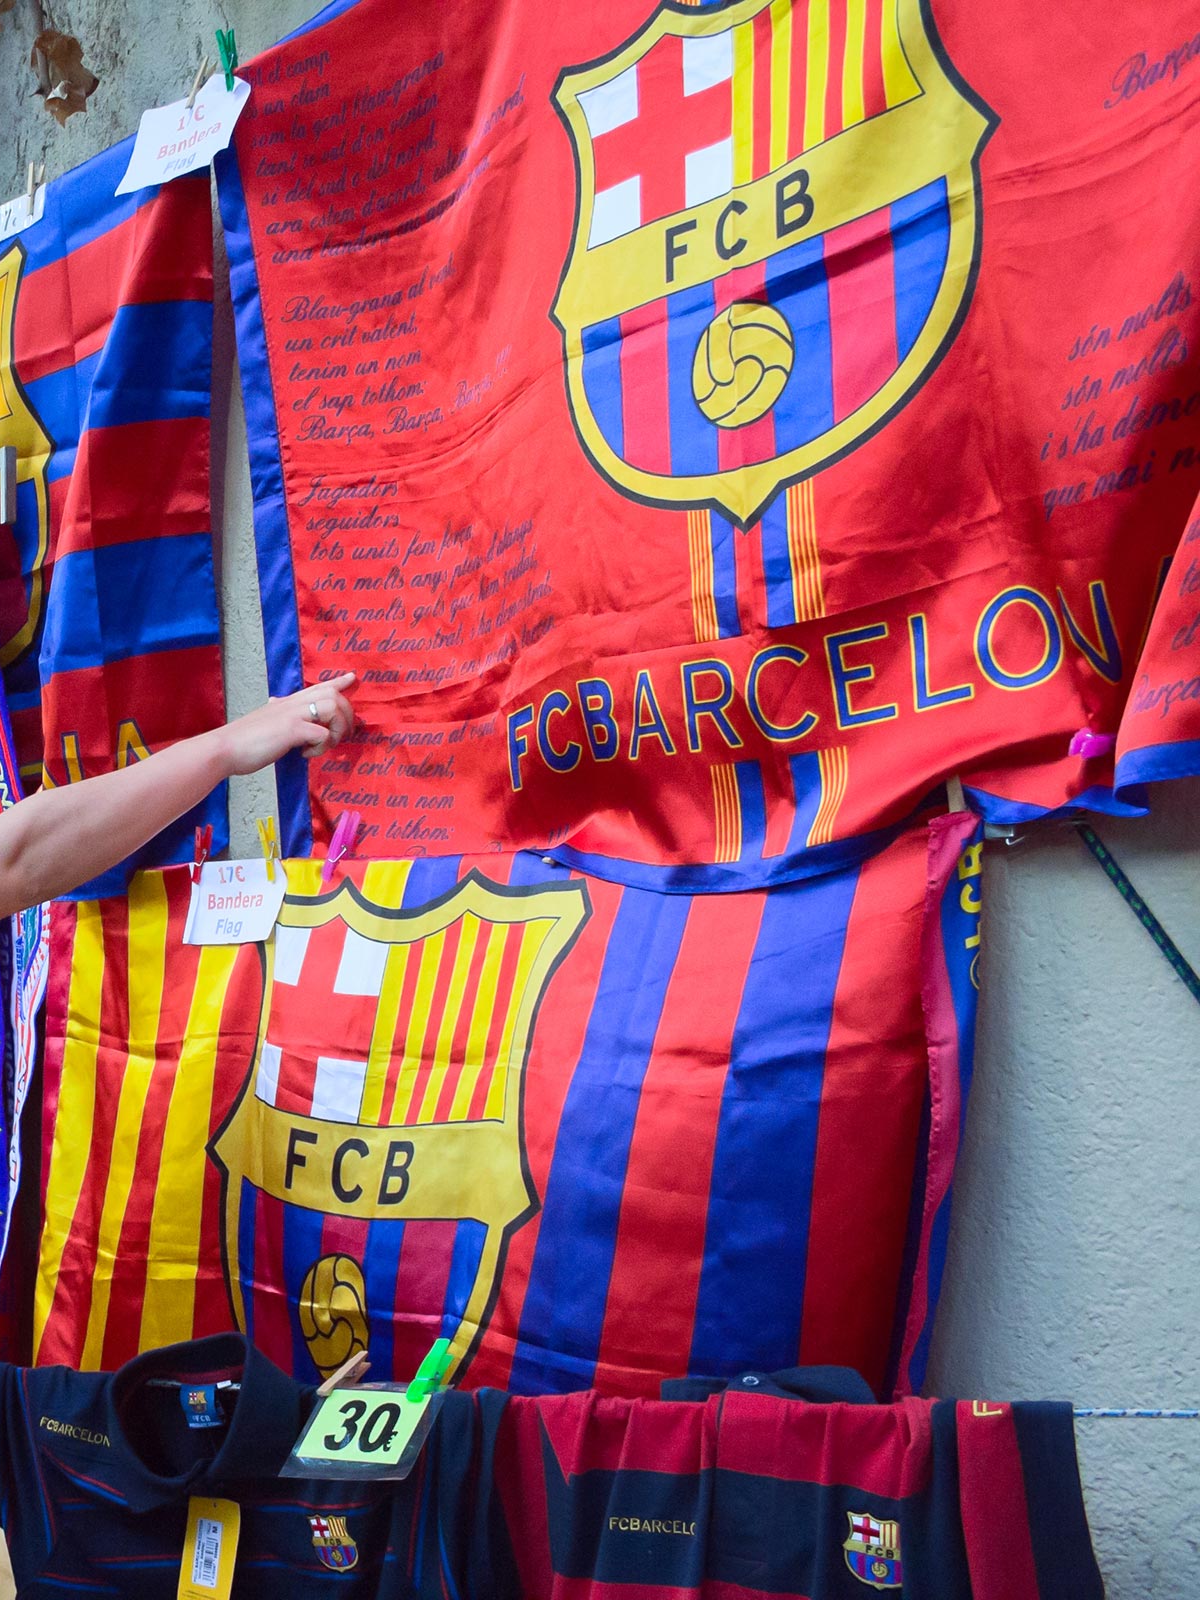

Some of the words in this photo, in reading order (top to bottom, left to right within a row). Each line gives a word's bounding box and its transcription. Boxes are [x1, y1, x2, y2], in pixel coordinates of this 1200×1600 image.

[156, 121, 222, 161] Bandera
[163, 153, 196, 175] Flag
[285, 171, 318, 203] del
[266, 219, 303, 235] ara
[665, 169, 814, 283] FCB
[272, 247, 313, 264] una
[281, 292, 403, 323] Blau-grana
[408, 265, 429, 299] al
[1067, 324, 1111, 361] són
[1117, 270, 1192, 341] molts
[284, 336, 313, 352] un
[320, 327, 358, 349] crit
[287, 358, 348, 382] tenim
[354, 360, 379, 376] un
[384, 349, 422, 372] nom
[1061, 375, 1102, 411] són
[1109, 325, 1188, 393] molts
[292, 386, 315, 413] el
[319, 391, 354, 418] sap
[1040, 432, 1053, 461] i
[1057, 410, 1105, 460] s'ha
[299, 474, 399, 509] Jugadors
[1042, 481, 1086, 523] que
[1092, 450, 1156, 498] mai
[305, 506, 400, 539] seguidors
[309, 541, 344, 561] tots
[351, 538, 399, 560] units
[401, 530, 436, 566] fem
[312, 575, 346, 594] són
[354, 566, 404, 591] molts
[410, 570, 448, 594] anys
[314, 604, 348, 623] són
[354, 596, 405, 622] molts
[410, 592, 445, 629] gols
[450, 593, 474, 623] que
[316, 632, 326, 650] i
[331, 625, 371, 652] s'ha
[361, 668, 400, 683] mai
[404, 660, 456, 687] ningú
[349, 722, 442, 753] lau-grana
[448, 722, 469, 744] al
[321, 759, 349, 773] un
[357, 753, 393, 775] crit
[320, 782, 380, 807] tenim
[386, 791, 410, 808] un
[415, 793, 455, 809] nom
[356, 824, 379, 845] ap
[218, 865, 246, 884] 17€
[207, 893, 263, 911] Bandera
[215, 918, 243, 937] Flag
[284, 1127, 415, 1206] FCB
[322, 1537, 342, 1547] FCB
[865, 1545, 895, 1559] FCB
